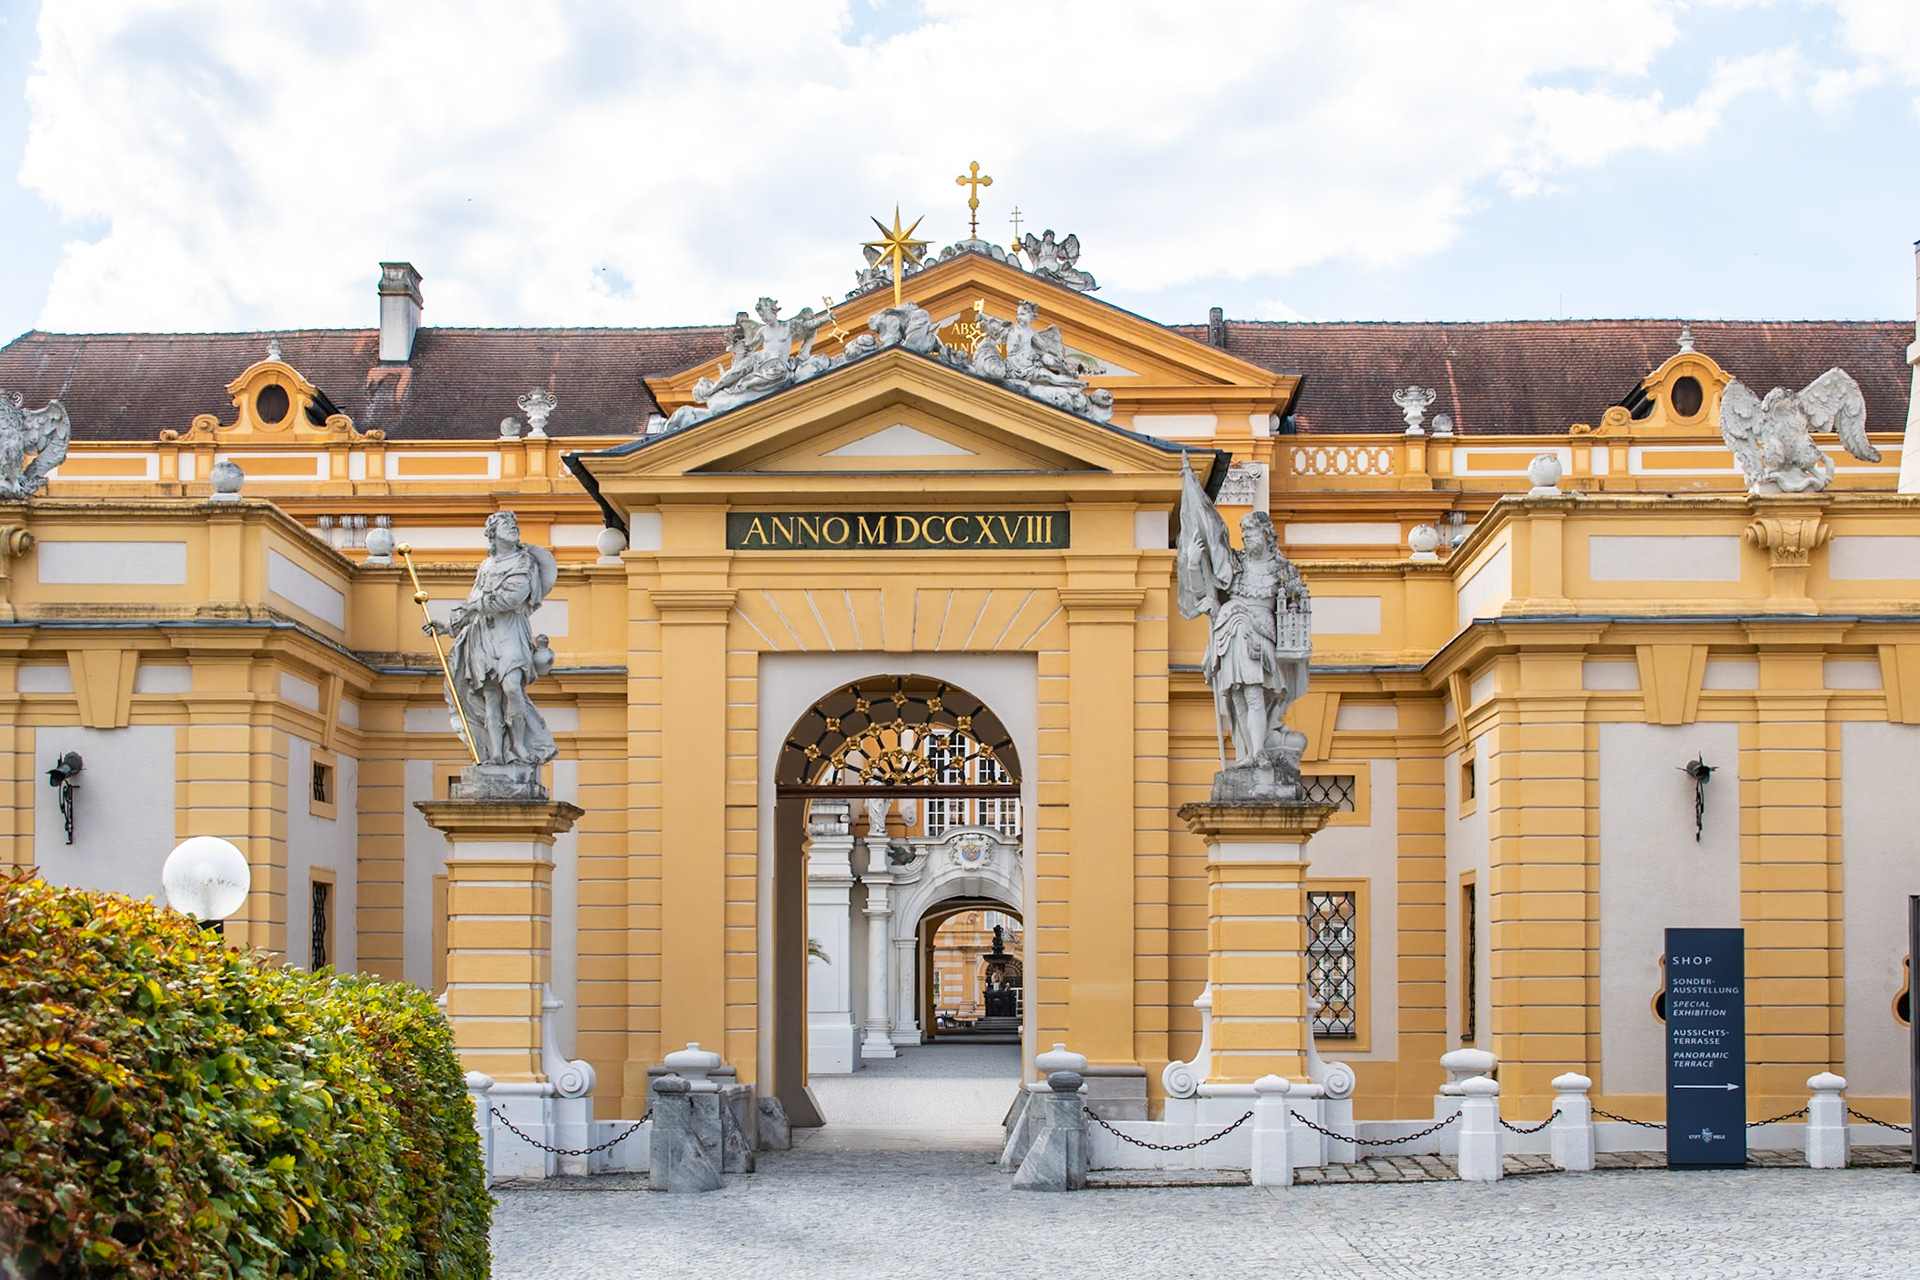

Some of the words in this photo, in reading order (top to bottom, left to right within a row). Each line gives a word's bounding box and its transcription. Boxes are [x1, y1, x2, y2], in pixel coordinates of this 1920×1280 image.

[741, 516, 850, 545] ANNO
[1672, 956, 1713, 966] SHOP
[1672, 978, 1716, 986] SONDER-
[1672, 986, 1740, 994] AUSSTELLUNG
[1673, 1000, 1711, 1008] SPECIAL
[1673, 1009, 1727, 1017] EXHIBITION
[1673, 1029, 1730, 1037] AUSSICHTS-
[1673, 1037, 1721, 1045] TERRASSE
[1673, 1052, 1729, 1060] PANORAMIC
[1673, 1060, 1714, 1068] TERRACE
